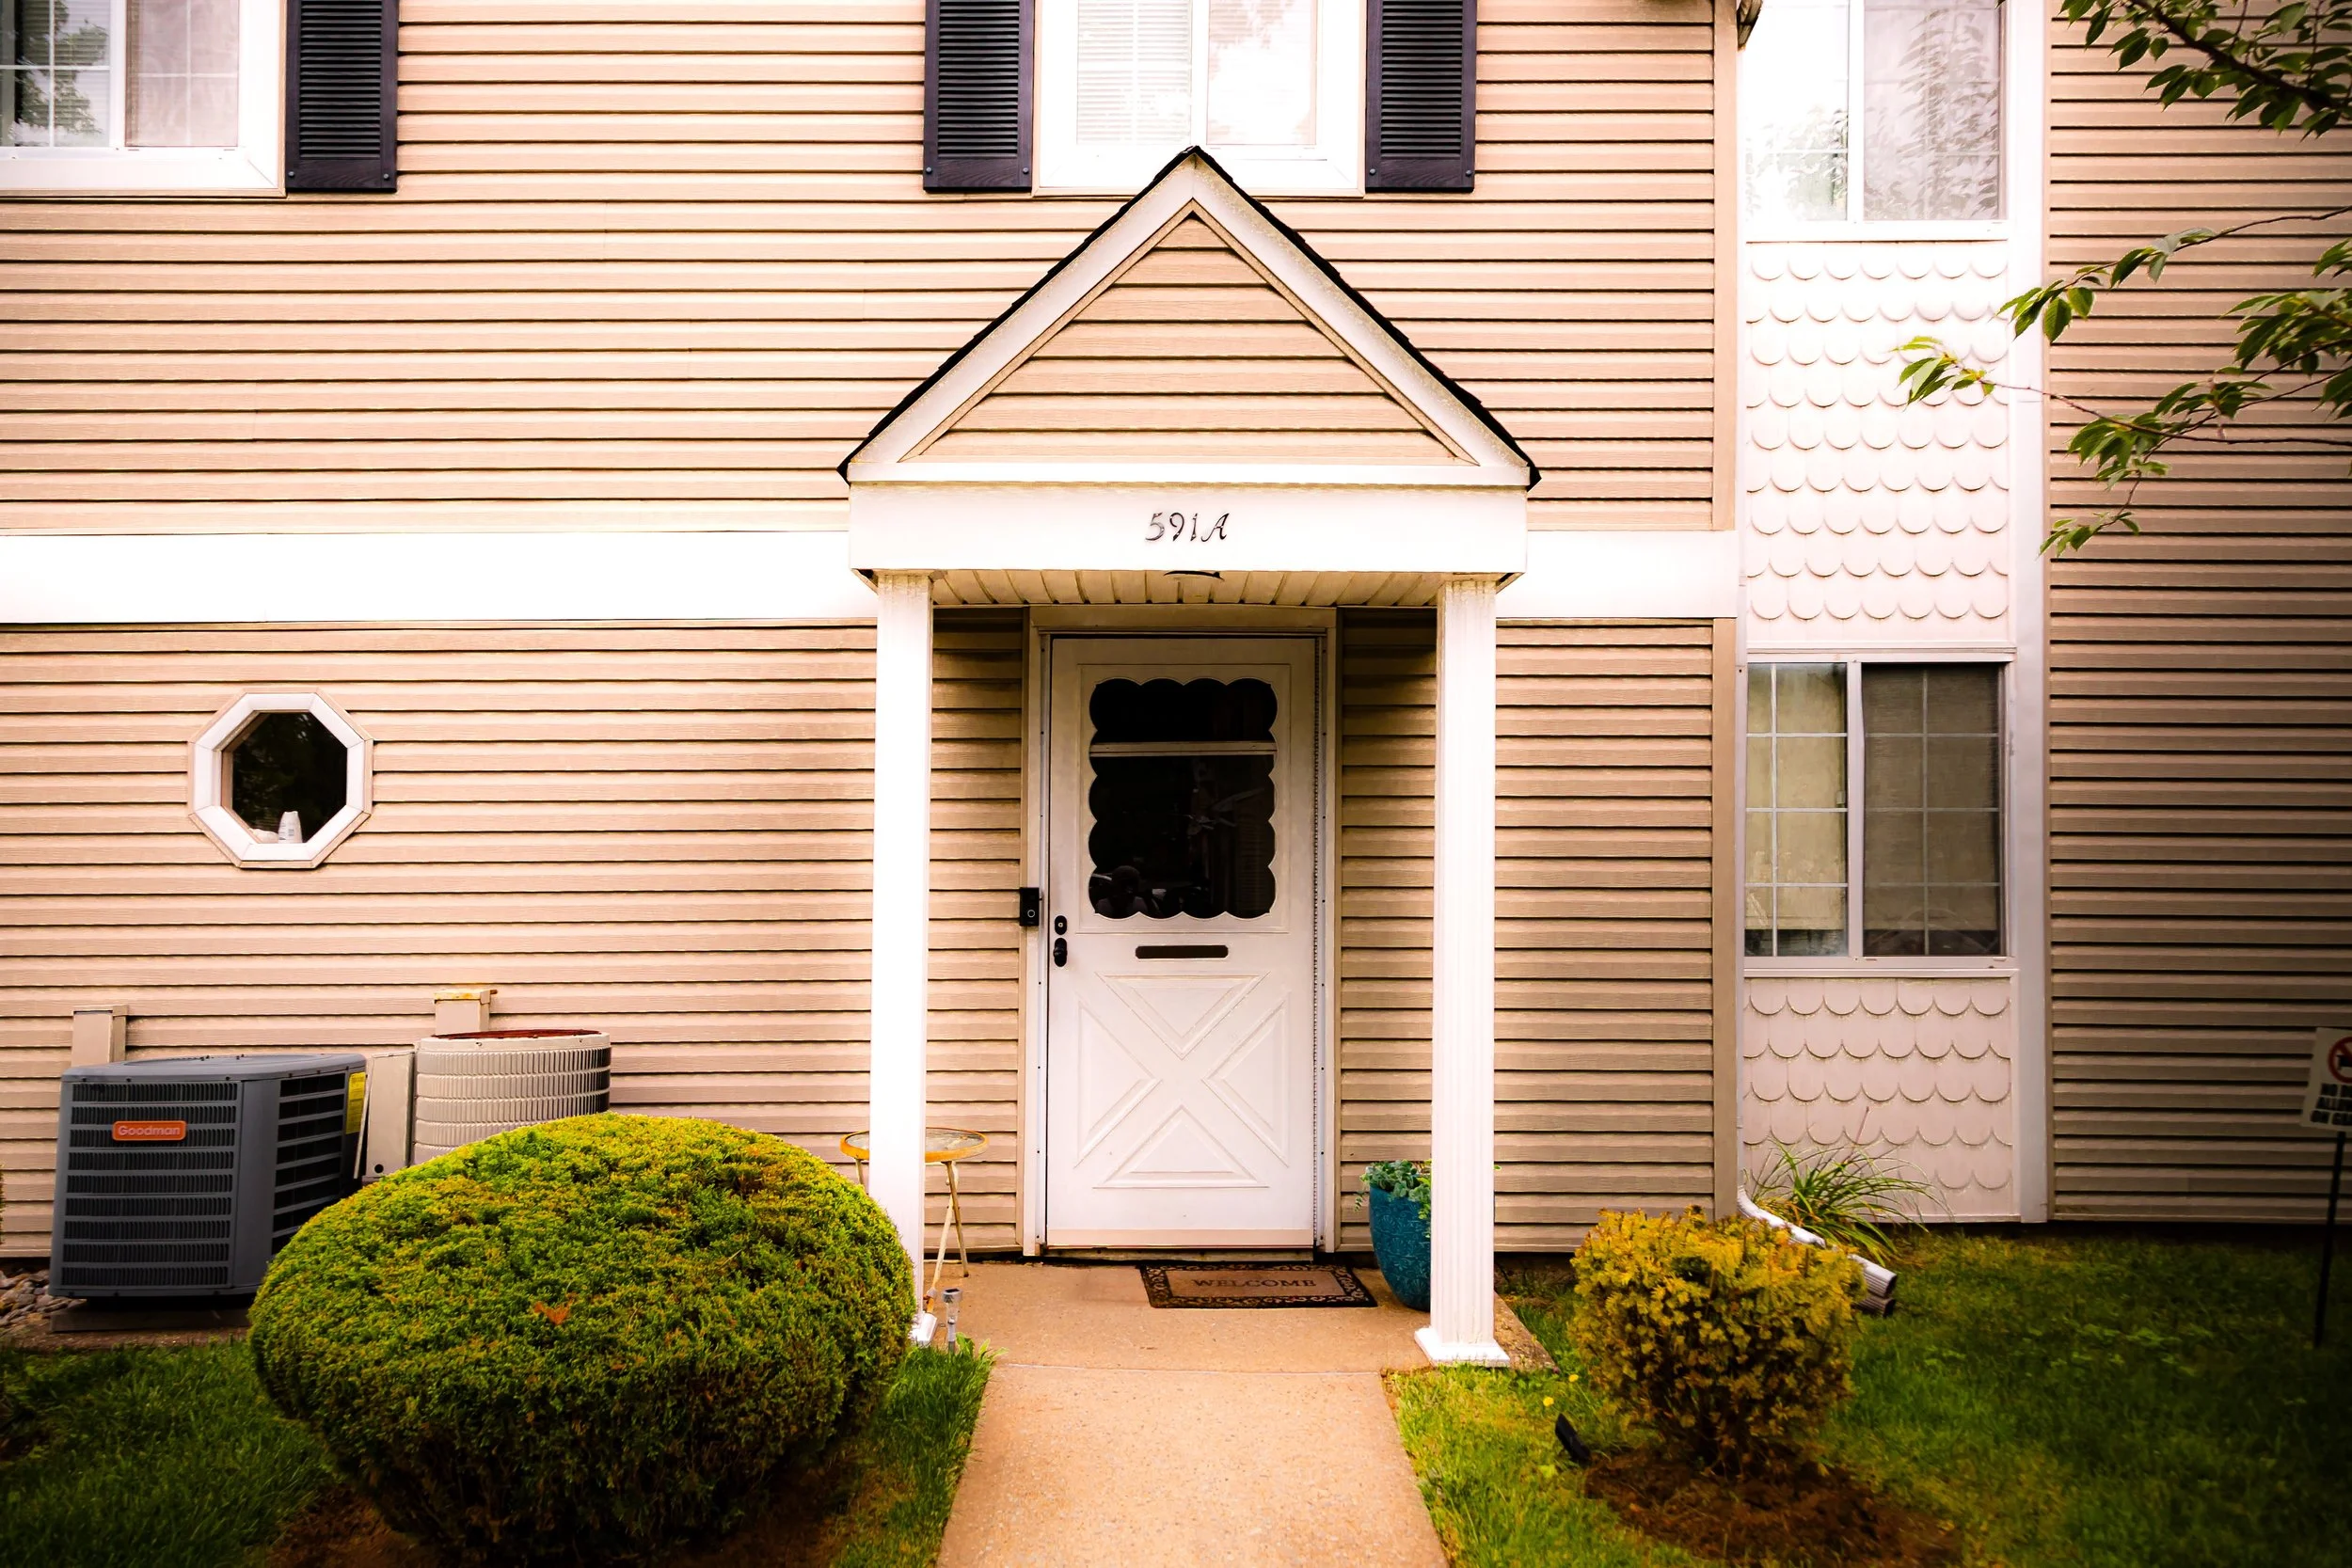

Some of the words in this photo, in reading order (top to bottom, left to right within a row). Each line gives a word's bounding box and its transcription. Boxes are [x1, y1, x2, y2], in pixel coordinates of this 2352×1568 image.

[1145, 512, 1230, 542] 591A
[119, 1125, 181, 1136] Goodman
[1193, 1278, 1317, 1288] WELCOME
